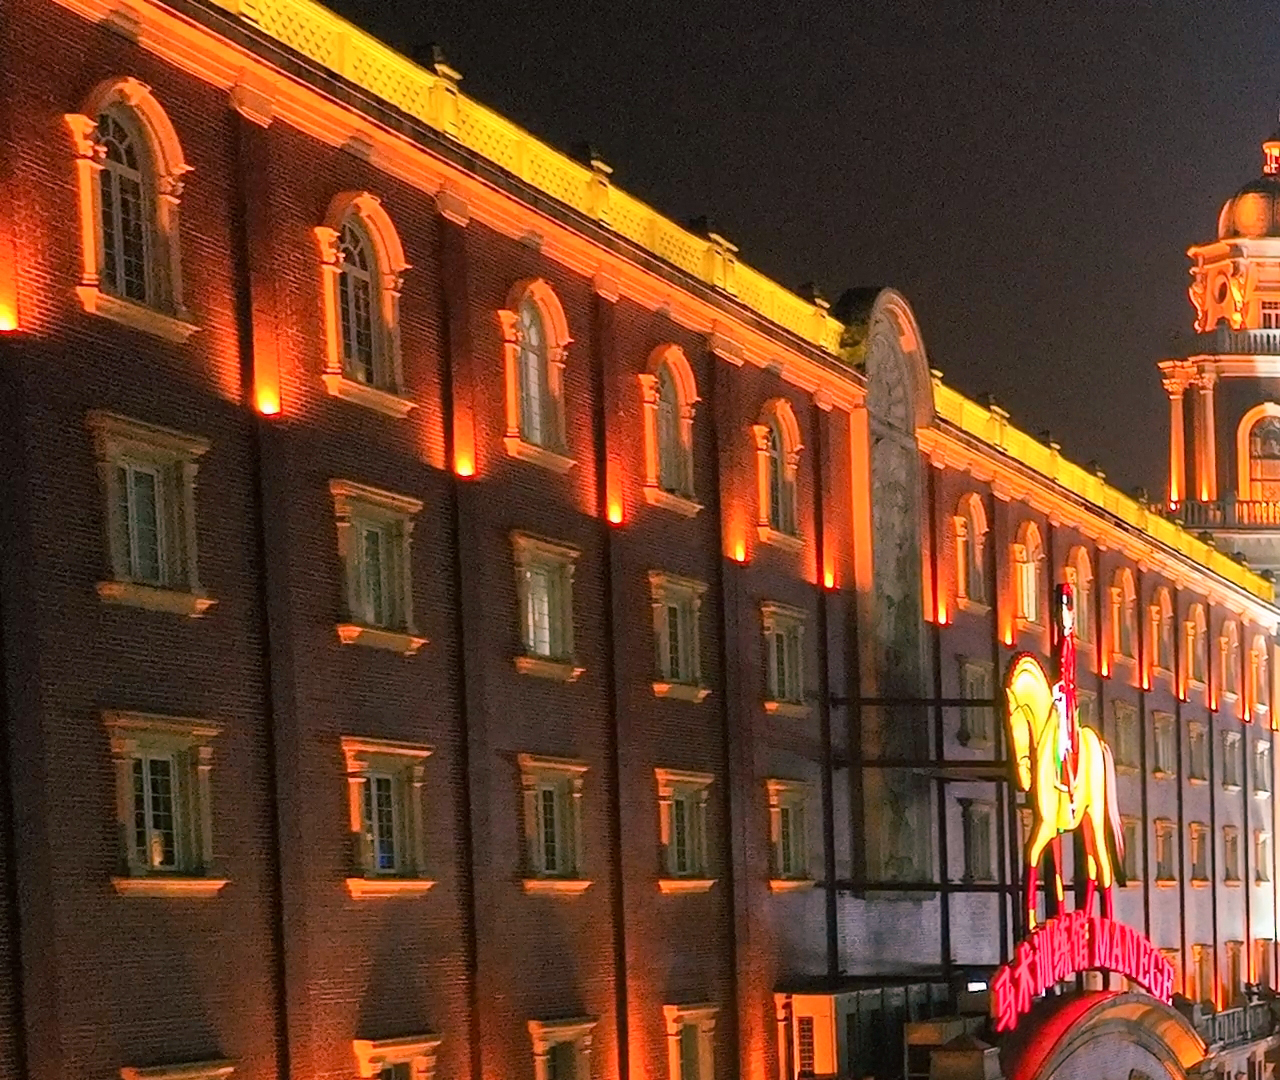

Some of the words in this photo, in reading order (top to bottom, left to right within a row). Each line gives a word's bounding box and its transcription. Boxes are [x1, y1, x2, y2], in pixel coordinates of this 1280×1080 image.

[993, 909, 1090, 1032] 马术训练馆
[1093, 919, 1175, 1006] MANEGE
